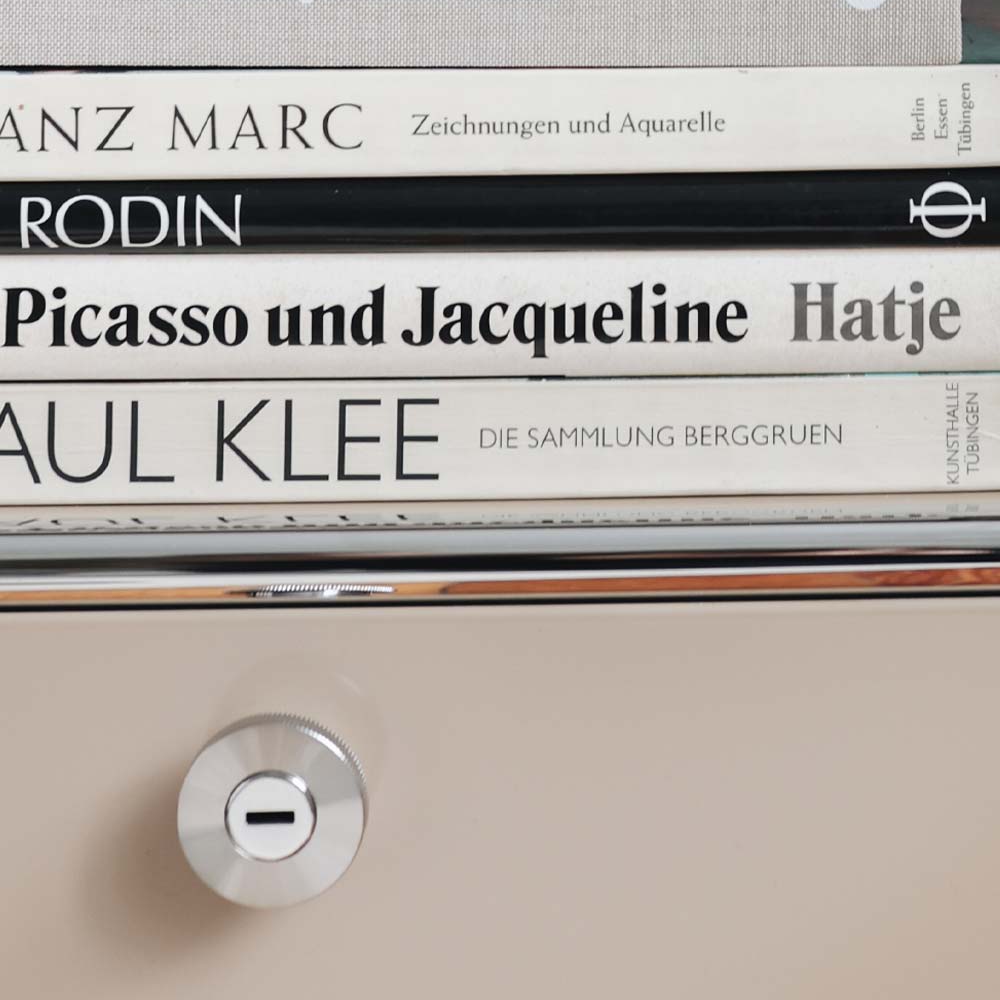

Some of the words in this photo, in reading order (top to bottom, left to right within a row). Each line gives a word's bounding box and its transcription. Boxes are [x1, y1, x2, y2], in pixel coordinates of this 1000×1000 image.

[167, 103, 364, 150] MARC
[411, 113, 560, 140] Zeichnungen
[569, 112, 611, 133] und
[620, 111, 726, 137] Aquarelle
[911, 97, 925, 141] Berlin
[934, 98, 949, 139] Essen
[957, 82, 974, 156] Tübingen
[19, 194, 242, 249] RODIN
[1, 286, 249, 347] Picasso
[265, 284, 387, 346] und
[401, 281, 749, 358] Jacqueline
[789, 280, 962, 356] Hatje
[216, 398, 440, 482] KLEE
[479, 427, 519, 449] DIE
[527, 425, 675, 449] SAMMLUNG
[684, 423, 843, 447] BERGGRUEN
[946, 382, 960, 485] KUNSTHALLE
[964, 392, 980, 475] TÜBINGEN
